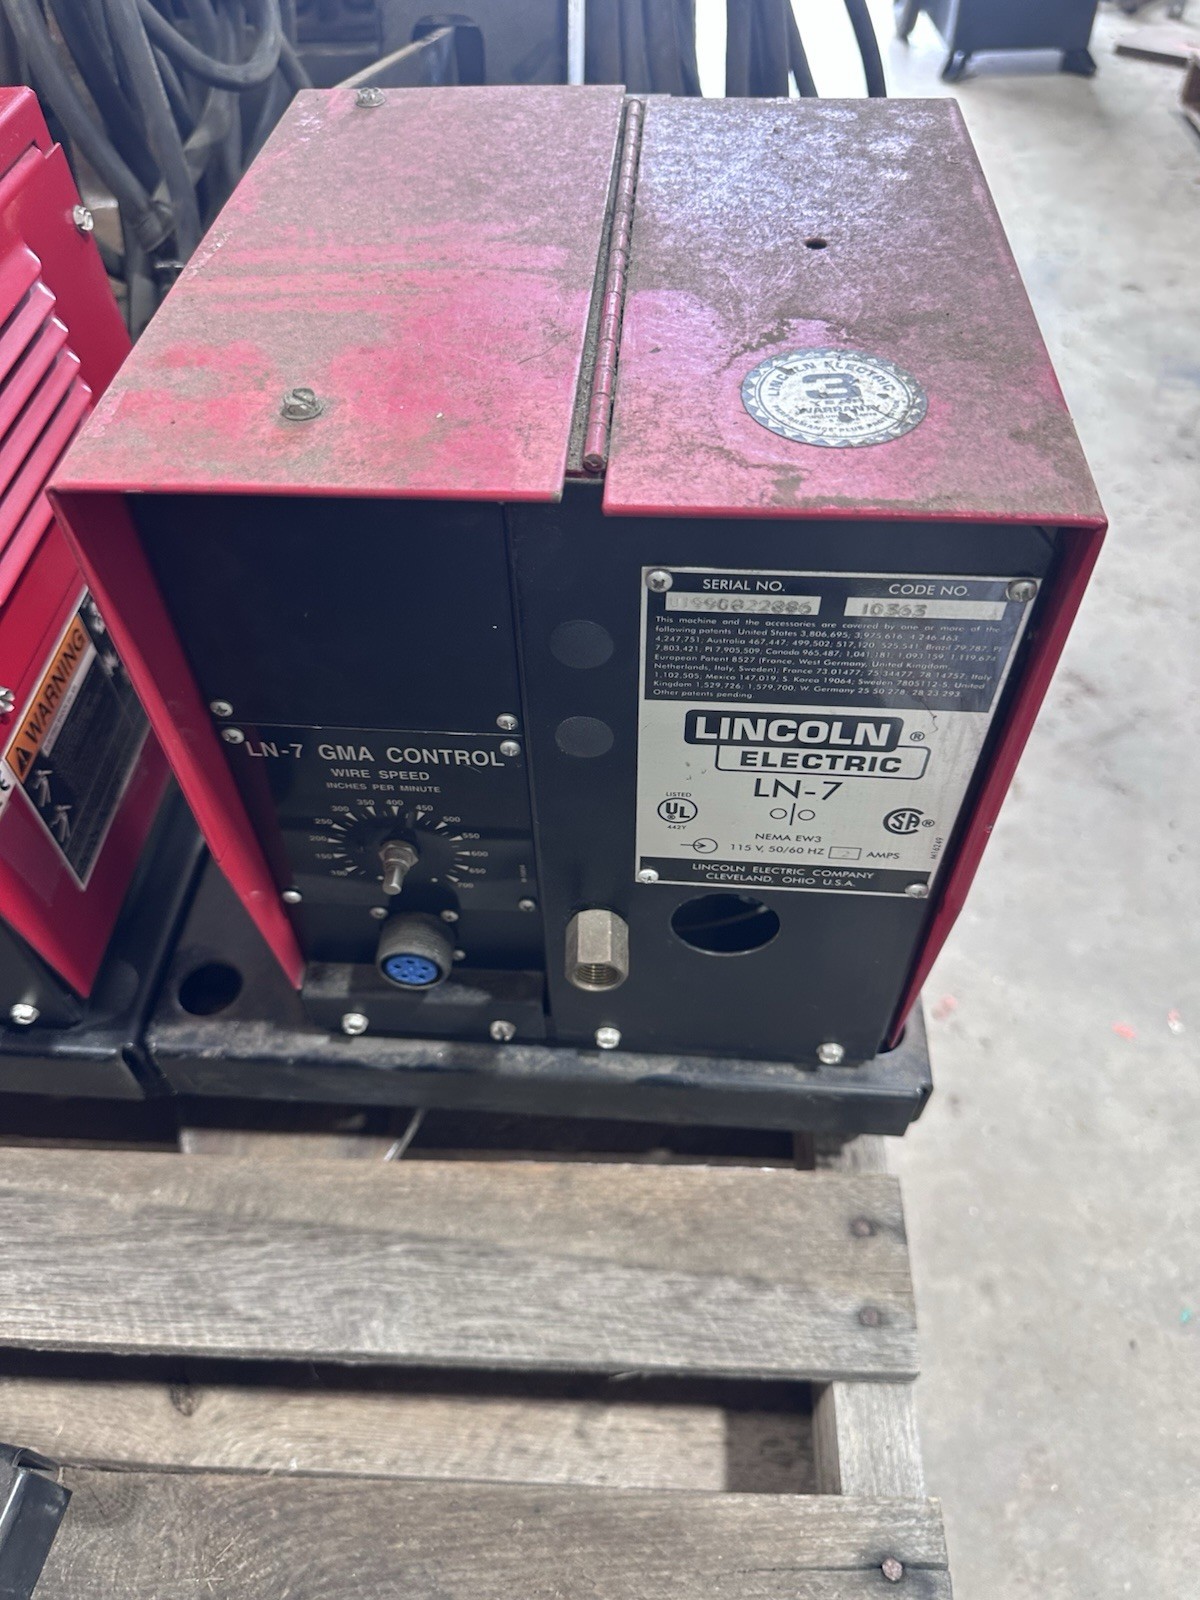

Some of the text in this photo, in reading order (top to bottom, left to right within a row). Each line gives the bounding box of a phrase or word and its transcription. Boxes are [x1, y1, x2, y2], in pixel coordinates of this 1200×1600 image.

[802, 372, 862, 399] 3
[703, 578, 786, 592] SERIAL NO.
[889, 583, 970, 596] CODE NO.
[679, 617, 717, 625] machine
[765, 620, 816, 628] accessories
[655, 625, 696, 634] following
[737, 628, 768, 636] United
[654, 654, 698, 662] European
[654, 662, 712, 671] Netherlands,
[714, 664, 736, 673] Italy,
[25, 627, 86, 744] WARNING
[653, 680, 692, 689] Kingdom
[813, 686, 856, 695] Germany
[858, 678, 894, 686] Sweden
[681, 690, 714, 698] patents
[695, 716, 891, 747] LINCOLN
[245, 741, 506, 767] LN-7 GMA CONTROL
[740, 750, 902, 773] ELECTRIC
[330, 768, 430, 781] WIRE SPEED
[326, 782, 442, 794] INCHES PER MINUTE
[754, 778, 844, 800] LN-7
[665, 802, 691, 819] UL
[755, 833, 822, 843] NEMA EW3
[731, 843, 751, 852] 115
[768, 846, 804, 854] 50/60
[808, 847, 825, 856] HZ
[866, 851, 900, 860] AMPS
[692, 863, 875, 879] LINCOLN ELECTRIC COMPANY
[782, 876, 816, 885] OHIO
[822, 878, 856, 887] U.S.A.
